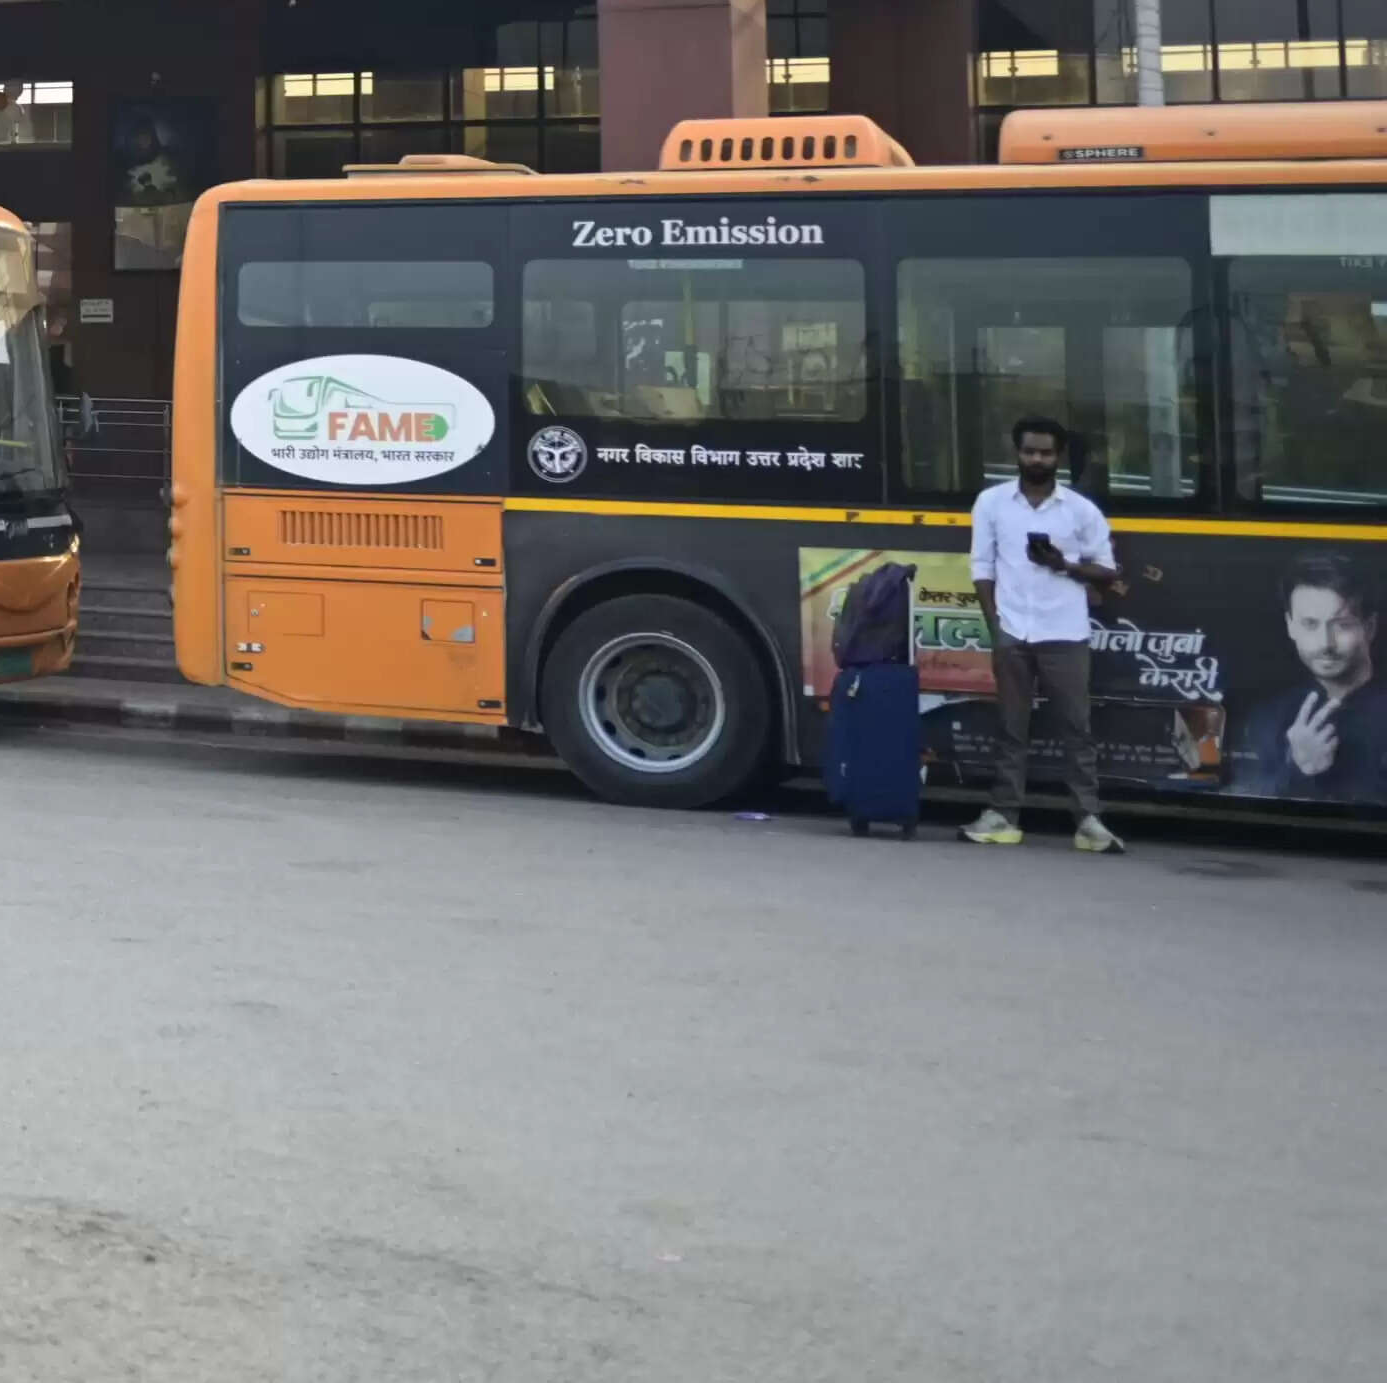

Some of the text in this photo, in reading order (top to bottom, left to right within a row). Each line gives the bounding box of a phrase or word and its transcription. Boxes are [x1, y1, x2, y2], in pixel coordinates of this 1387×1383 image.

[1075, 148, 1139, 158] SPHERE
[572, 216, 824, 247] Zero Emission
[328, 411, 449, 443] FAME
[271, 444, 456, 463] भारी उद्योग मंत्रालय, भारत सरकार
[596, 447, 630, 464] नगर
[634, 443, 686, 465] विकास
[690, 444, 741, 466] विभाग
[746, 449, 782, 467] उत्तर
[786, 445, 826, 471] प्रदेश
[1136, 653, 1224, 702] केसरी
